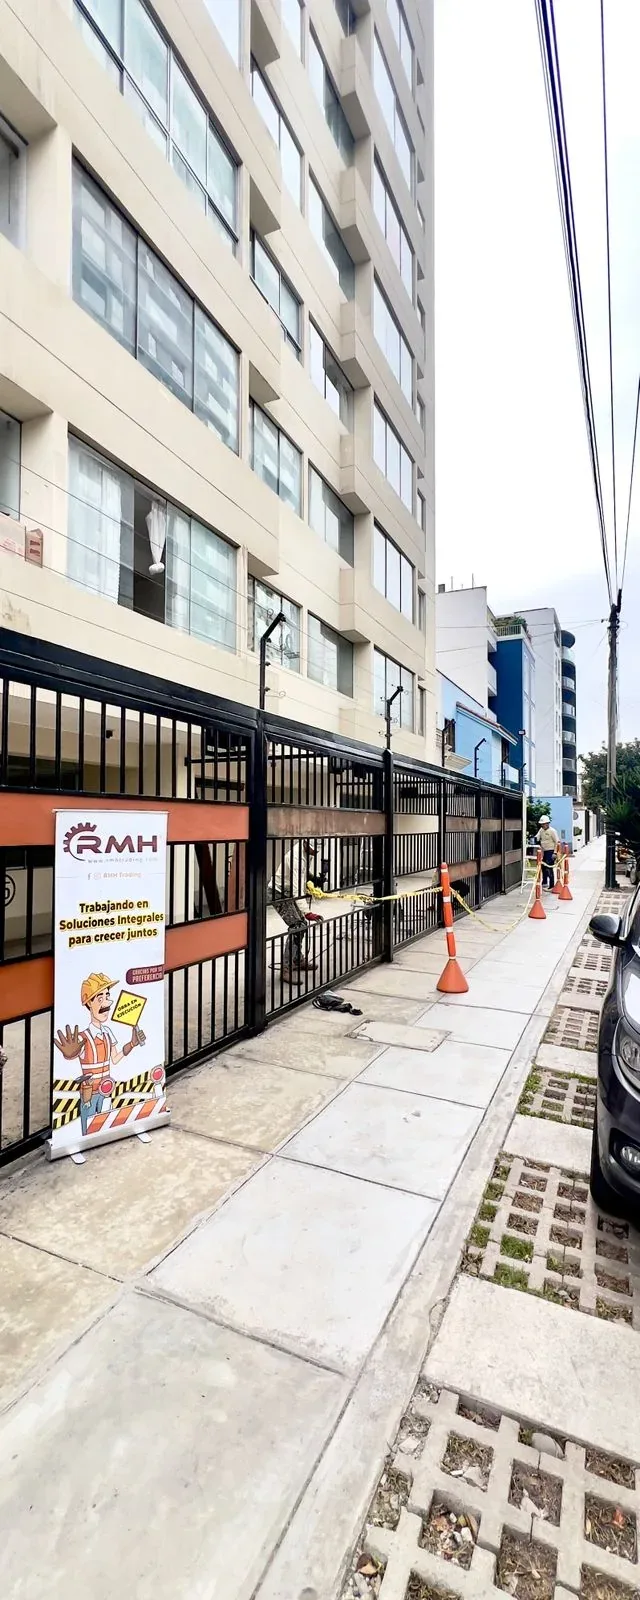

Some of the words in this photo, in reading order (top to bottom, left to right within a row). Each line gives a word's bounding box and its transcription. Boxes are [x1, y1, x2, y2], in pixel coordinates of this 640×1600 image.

[77, 835, 158, 854] RMH
[79, 900, 134, 914] Trabajando
[136, 900, 149, 909] en
[59, 917, 115, 931] Soluciones
[117, 912, 164, 926] Integrales
[68, 934, 92, 947] para
[94, 930, 125, 943] crecer
[126, 928, 158, 941] juntos
[118, 1003, 130, 1011] OBRA
